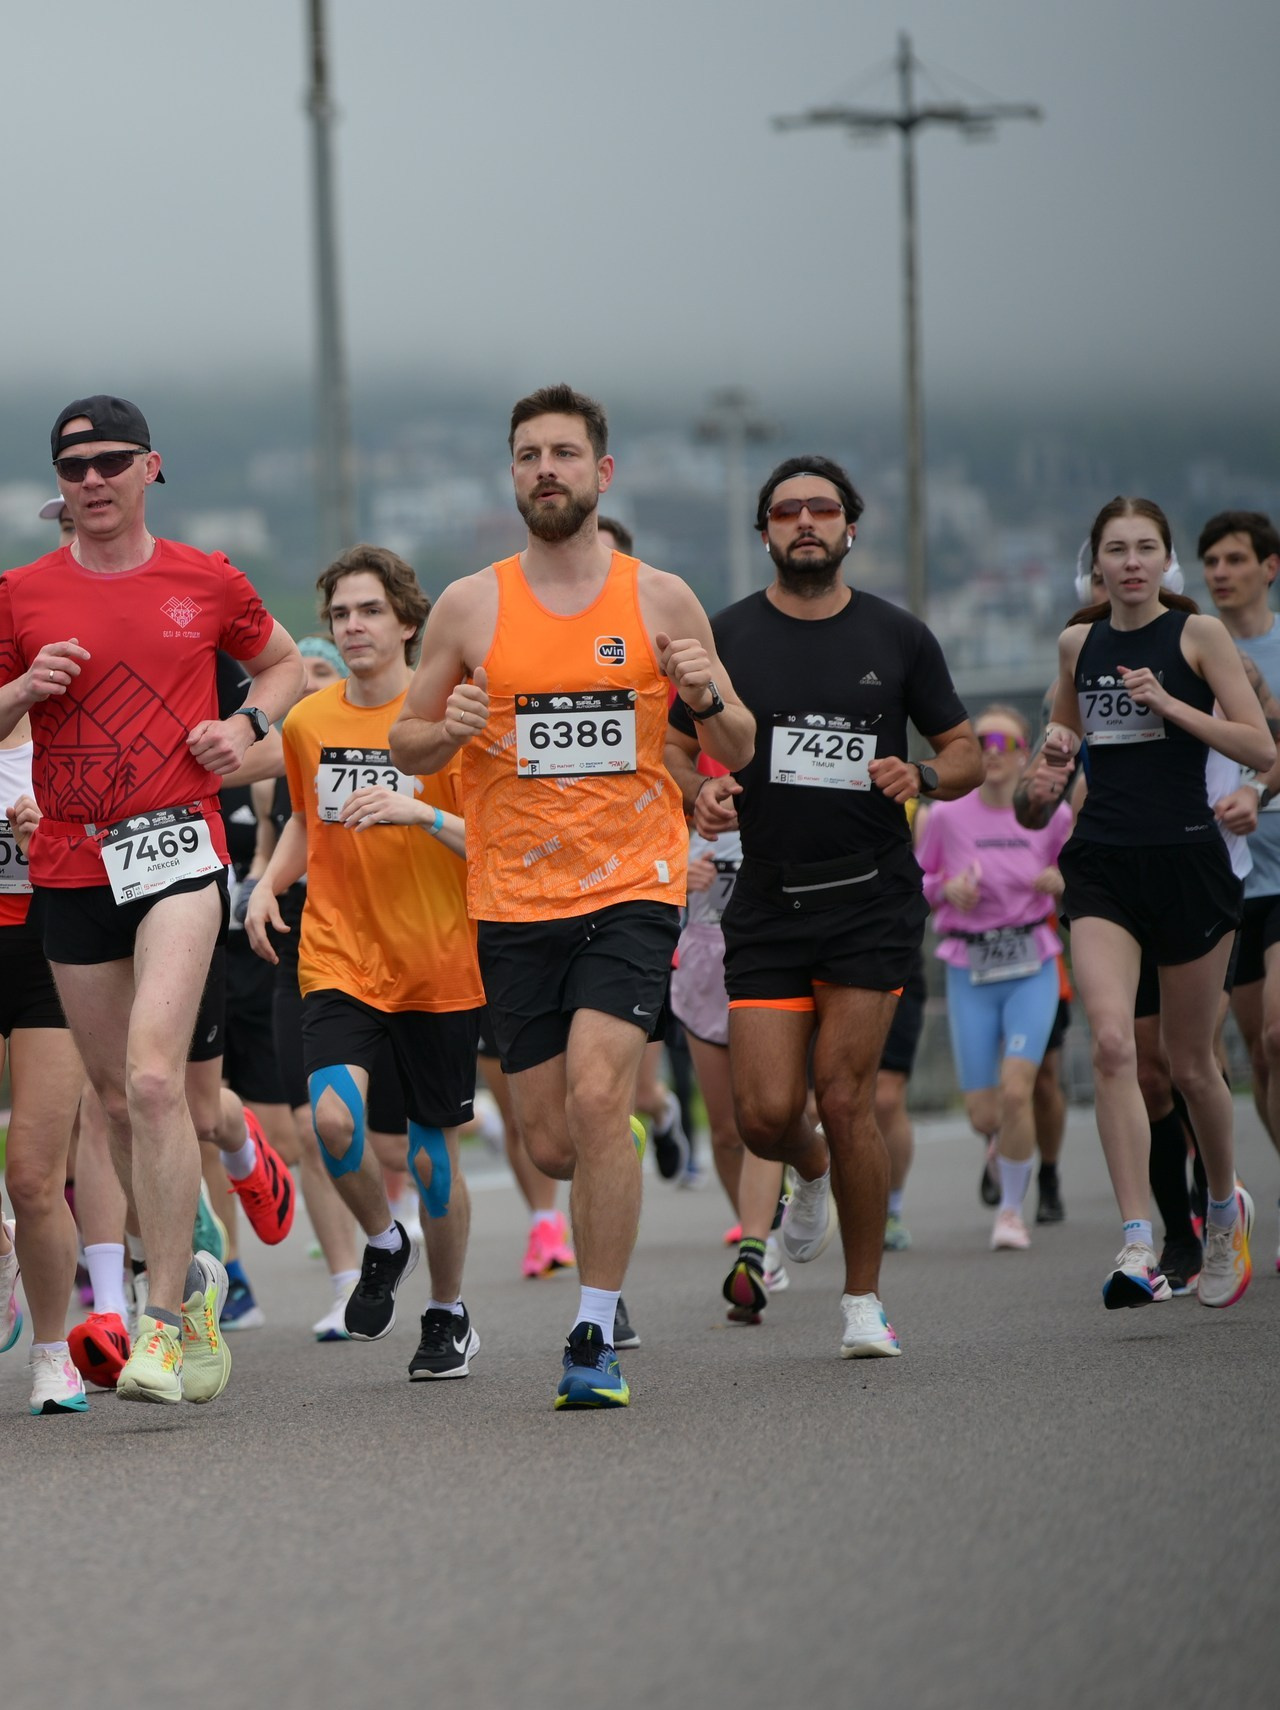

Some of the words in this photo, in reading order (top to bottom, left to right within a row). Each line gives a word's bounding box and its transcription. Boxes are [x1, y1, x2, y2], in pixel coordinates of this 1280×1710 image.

[601, 646, 624, 656] Win
[530, 699, 540, 708] 10
[529, 719, 623, 750] 6386
[786, 731, 865, 762] 7426
[330, 751, 337, 759] 10
[812, 760, 836, 768] TIMUR
[331, 768, 399, 793] 7133
[110, 828, 119, 836] 10
[115, 826, 199, 871] 7469
[523, 835, 563, 869] WINLINE
[147, 859, 181, 873] АЛЕКСЕЙ
[579, 853, 623, 892] WINLINE
[125, 889, 134, 899] B
